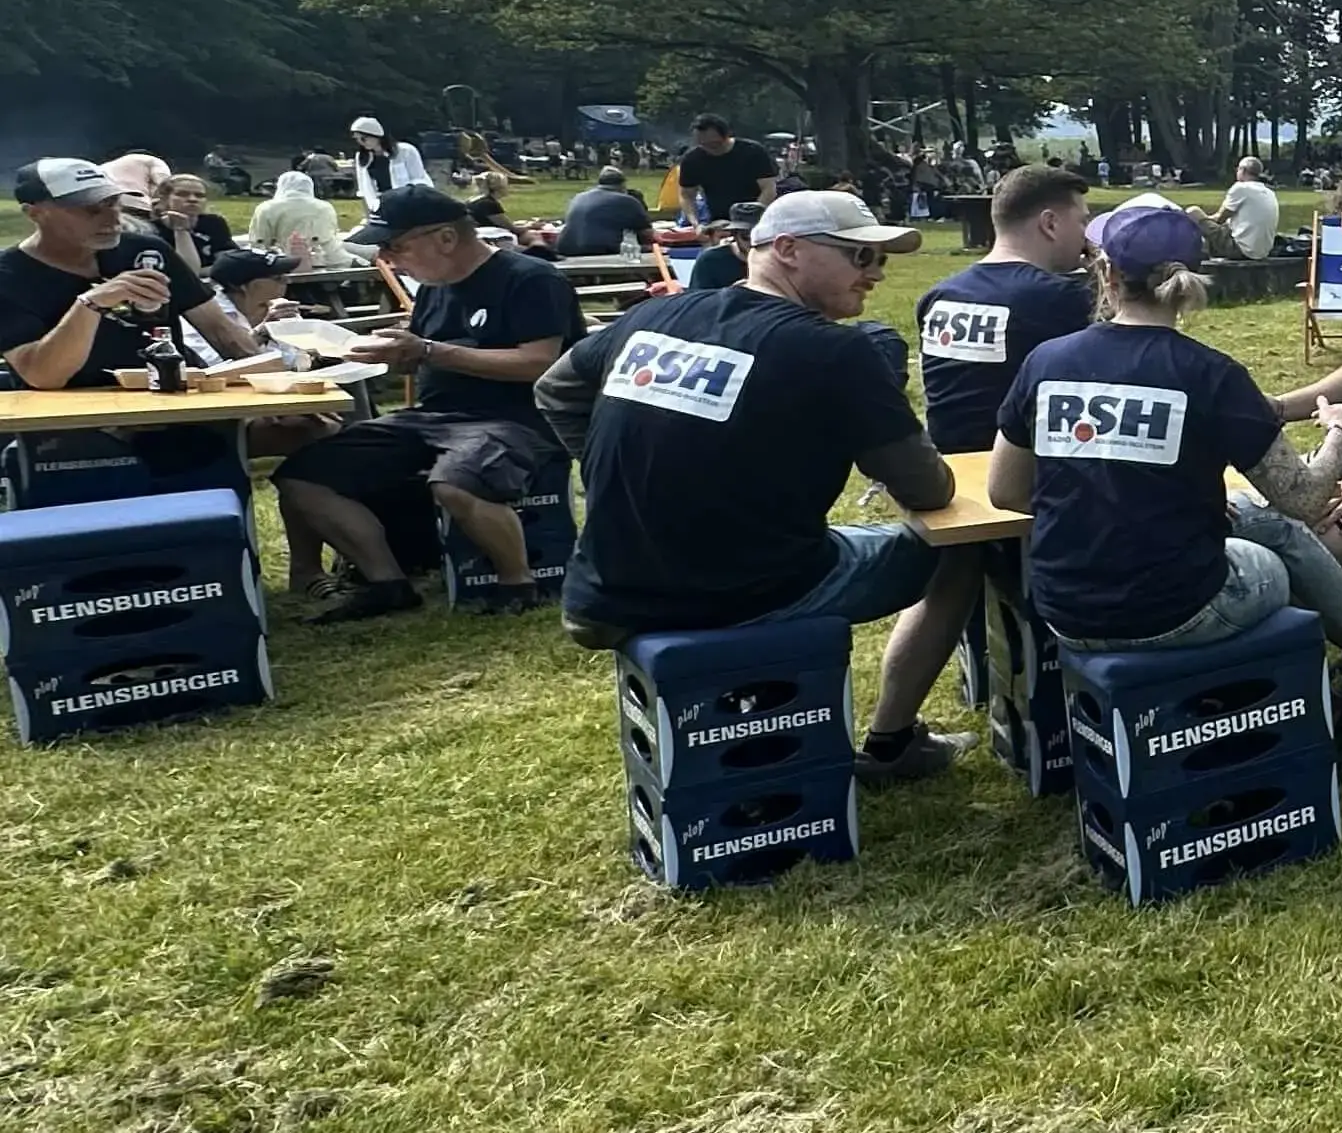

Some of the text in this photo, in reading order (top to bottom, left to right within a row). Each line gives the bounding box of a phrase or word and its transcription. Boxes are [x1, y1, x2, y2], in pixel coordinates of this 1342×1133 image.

[928, 309, 999, 344] RSH
[619, 342, 738, 398] RSH
[1047, 393, 1172, 441] RSH
[31, 582, 223, 624] FLENSBURGER
[51, 668, 240, 716] FLENSBURGER
[687, 707, 832, 748] FLENSBURGER
[1148, 697, 1306, 757] FLENSBURGER
[692, 818, 836, 863] FLENSBURGER
[1159, 805, 1316, 869] FLENSBURGER
